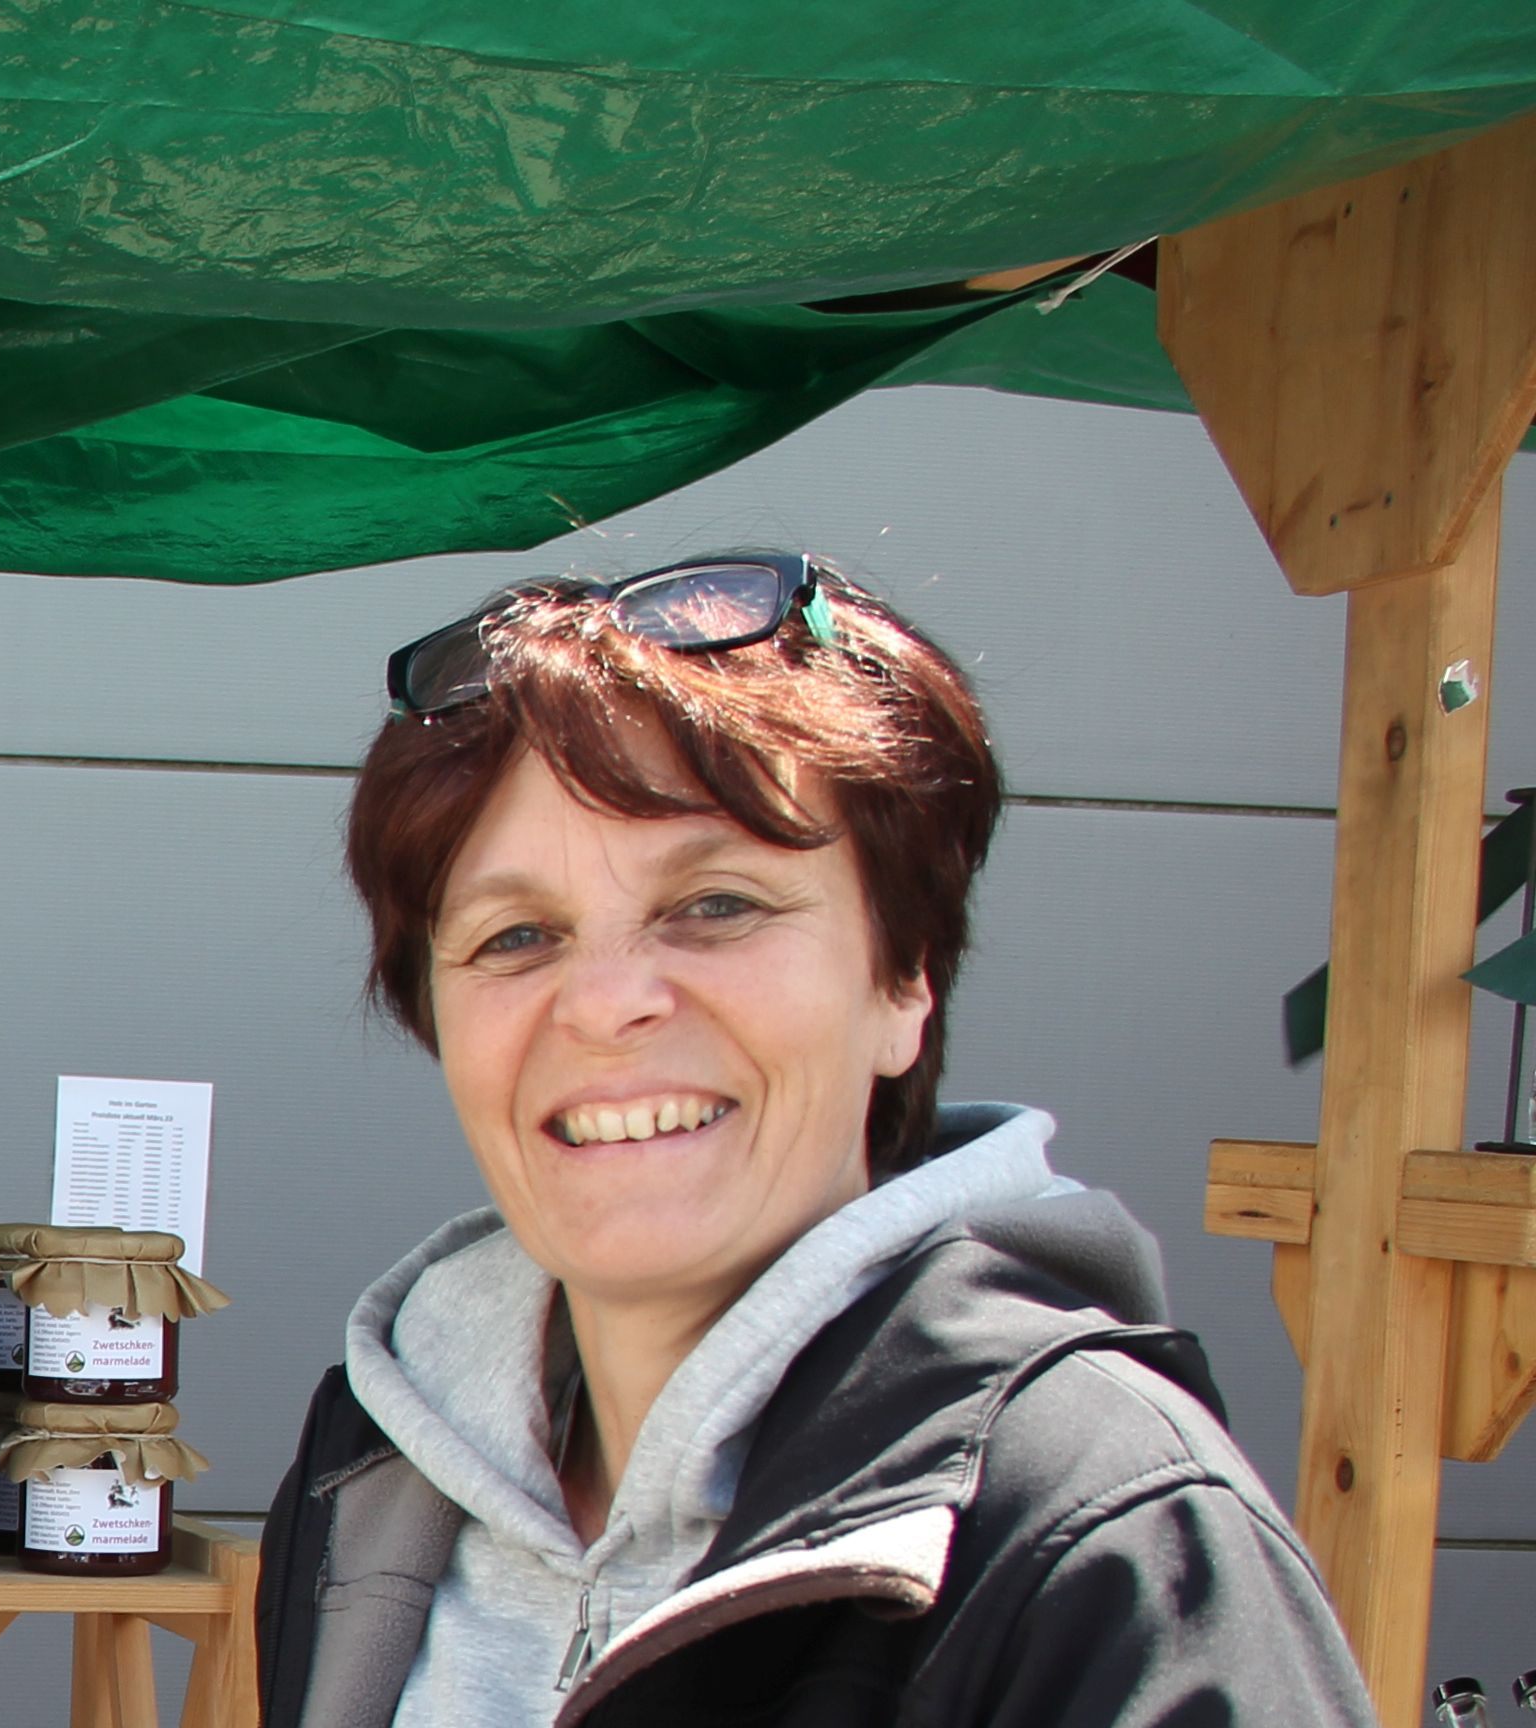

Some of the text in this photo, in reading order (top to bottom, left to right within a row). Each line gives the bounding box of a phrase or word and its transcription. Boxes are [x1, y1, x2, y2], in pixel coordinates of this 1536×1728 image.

[92, 1340, 155, 1350] Zwetschken-
[92, 1356, 151, 1366] marmelade
[92, 1519, 153, 1529] Zwetschken-
[92, 1533, 148, 1544] marmelade
